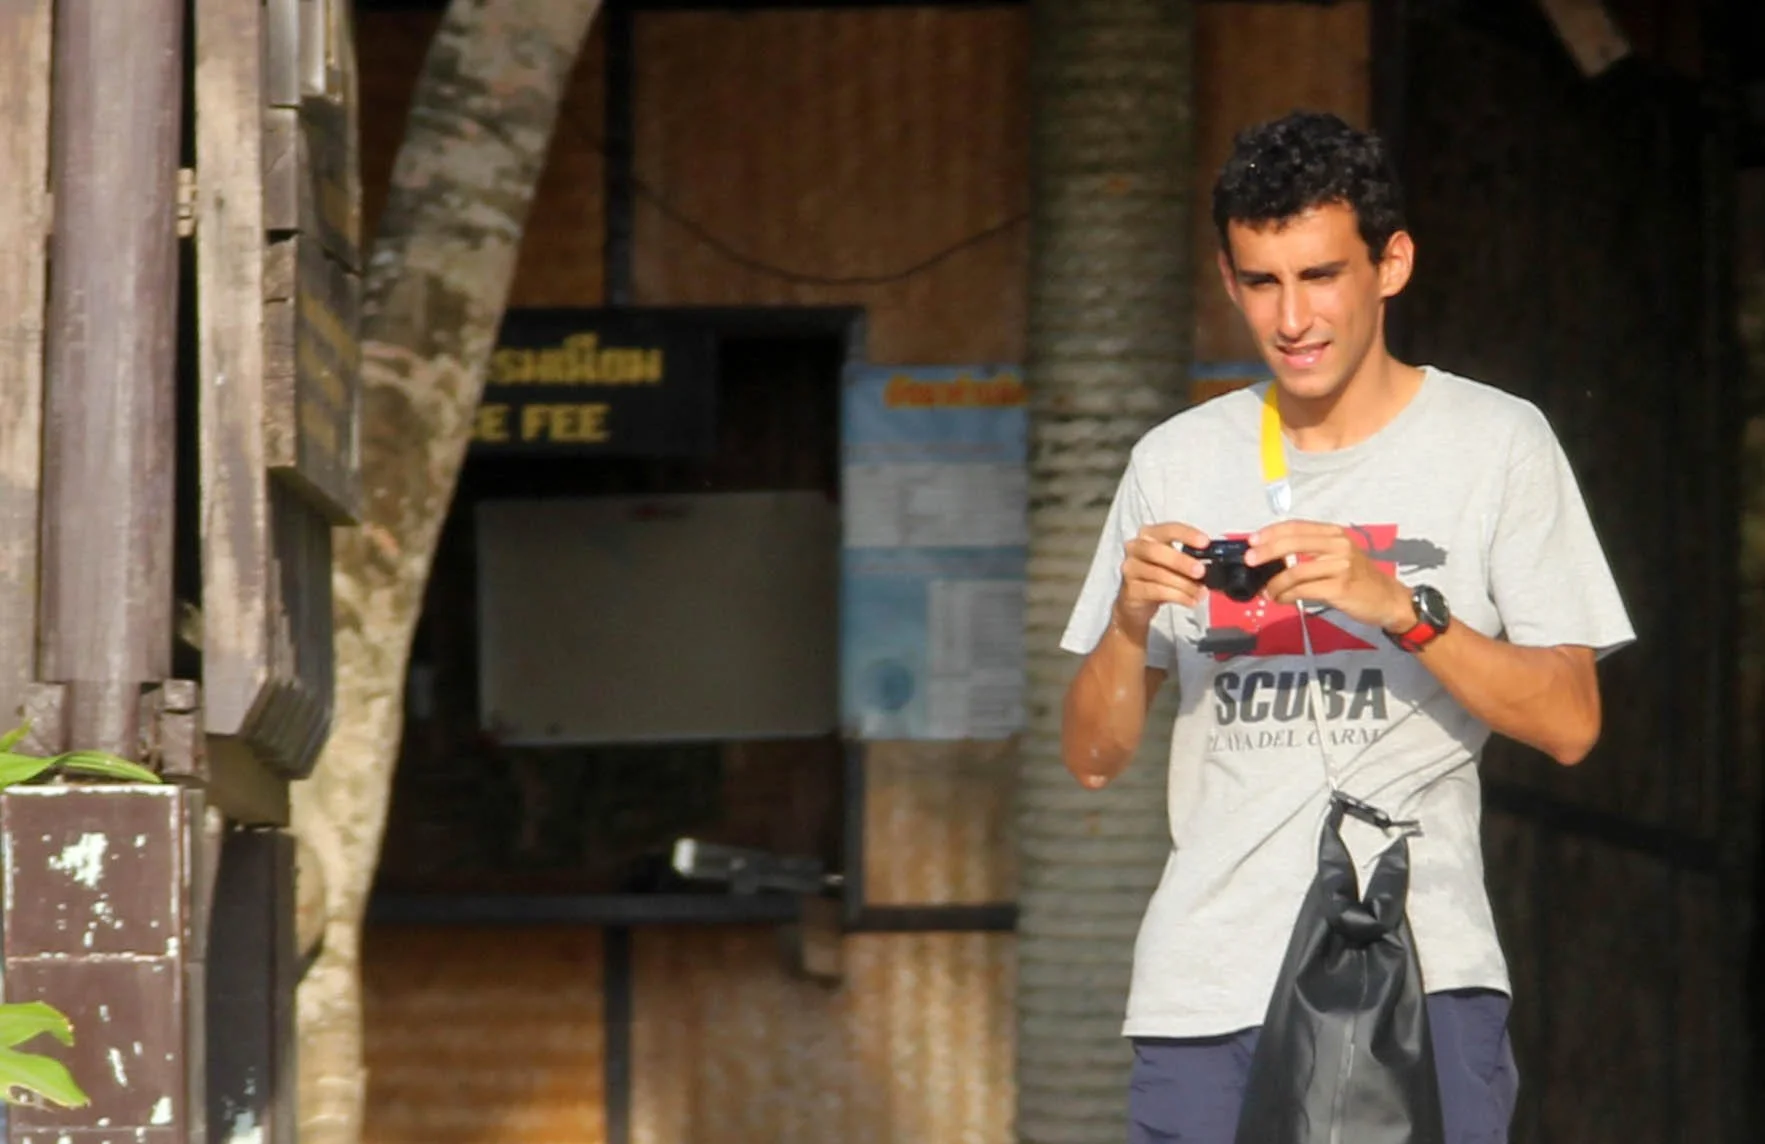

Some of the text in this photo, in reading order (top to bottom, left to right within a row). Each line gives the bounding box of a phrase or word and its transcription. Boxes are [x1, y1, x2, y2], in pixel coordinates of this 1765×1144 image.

[521, 404, 612, 443] FEE
[1213, 668, 1389, 726] SCUBA
[1258, 728, 1302, 749] DEL
